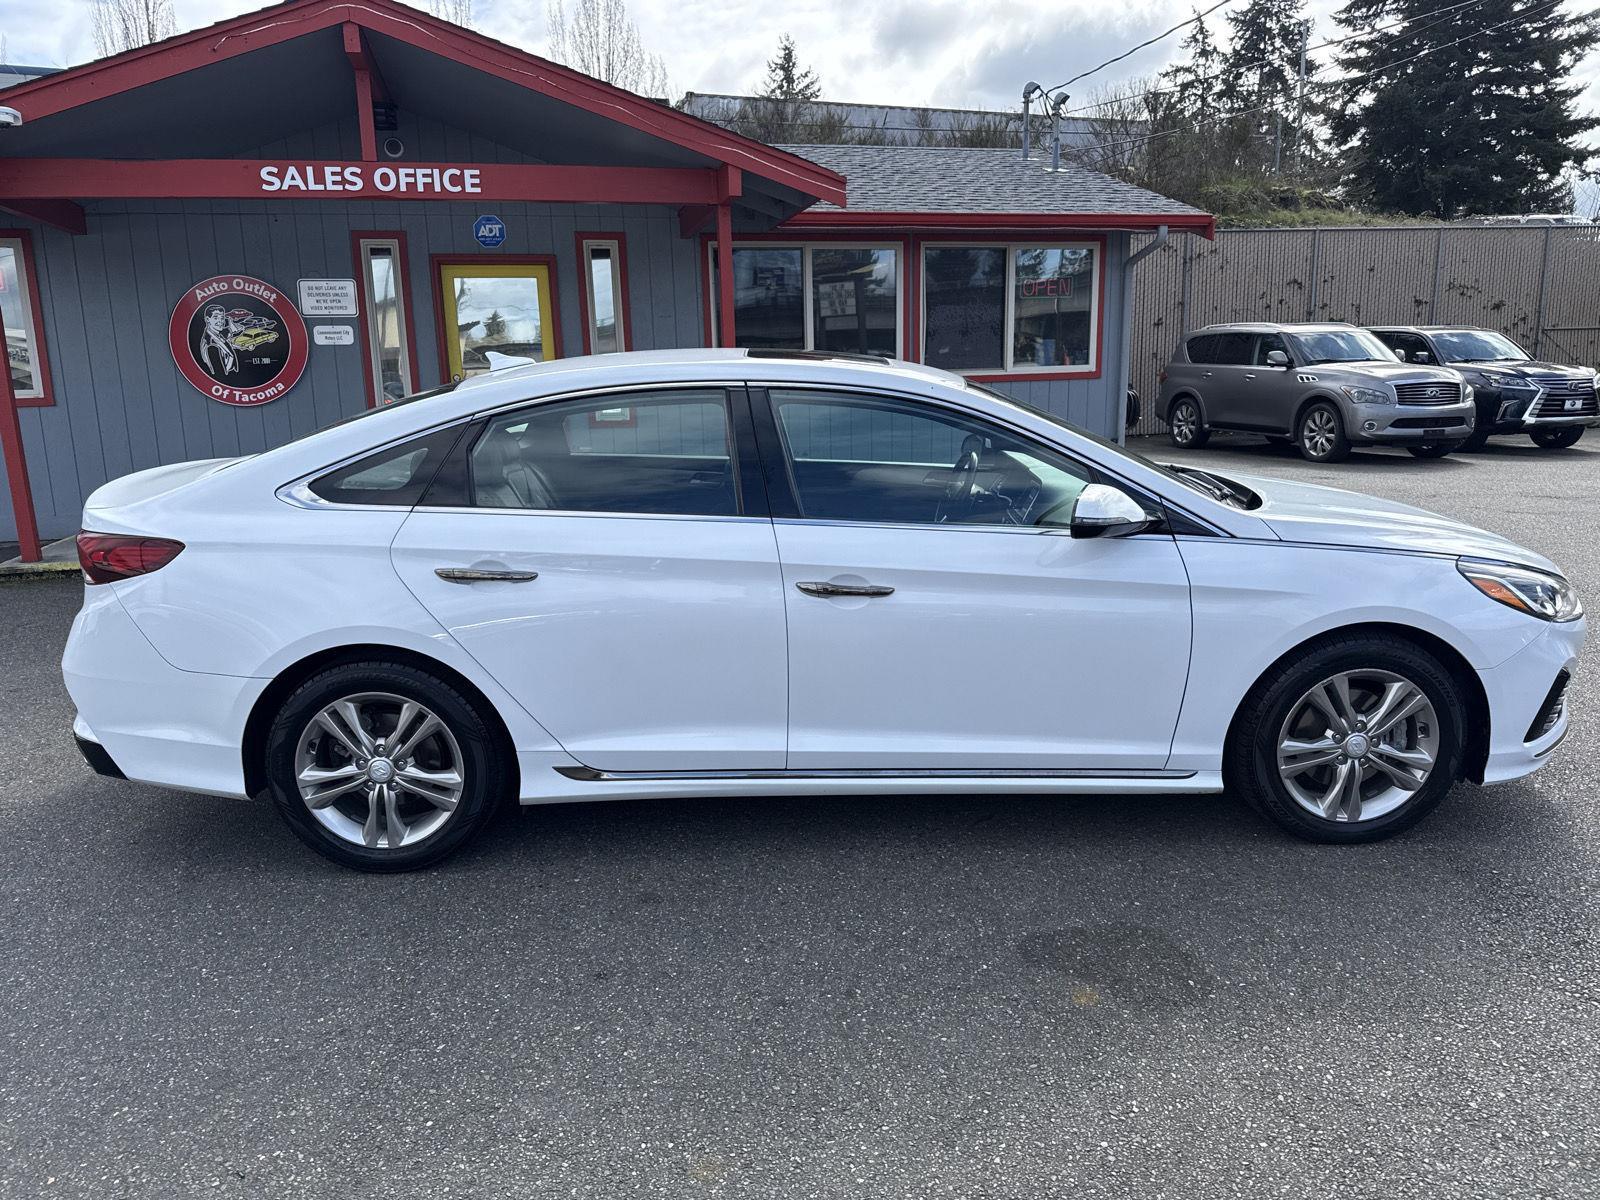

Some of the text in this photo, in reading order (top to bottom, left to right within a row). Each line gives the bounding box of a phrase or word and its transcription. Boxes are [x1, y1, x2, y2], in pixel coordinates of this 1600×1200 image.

[260, 166, 481, 193] SALES OFFICE
[478, 224, 503, 237] ADT
[194, 278, 278, 304] Auto Outlet
[1023, 279, 1070, 296] OPEN
[211, 382, 285, 402] Of Tacoma
